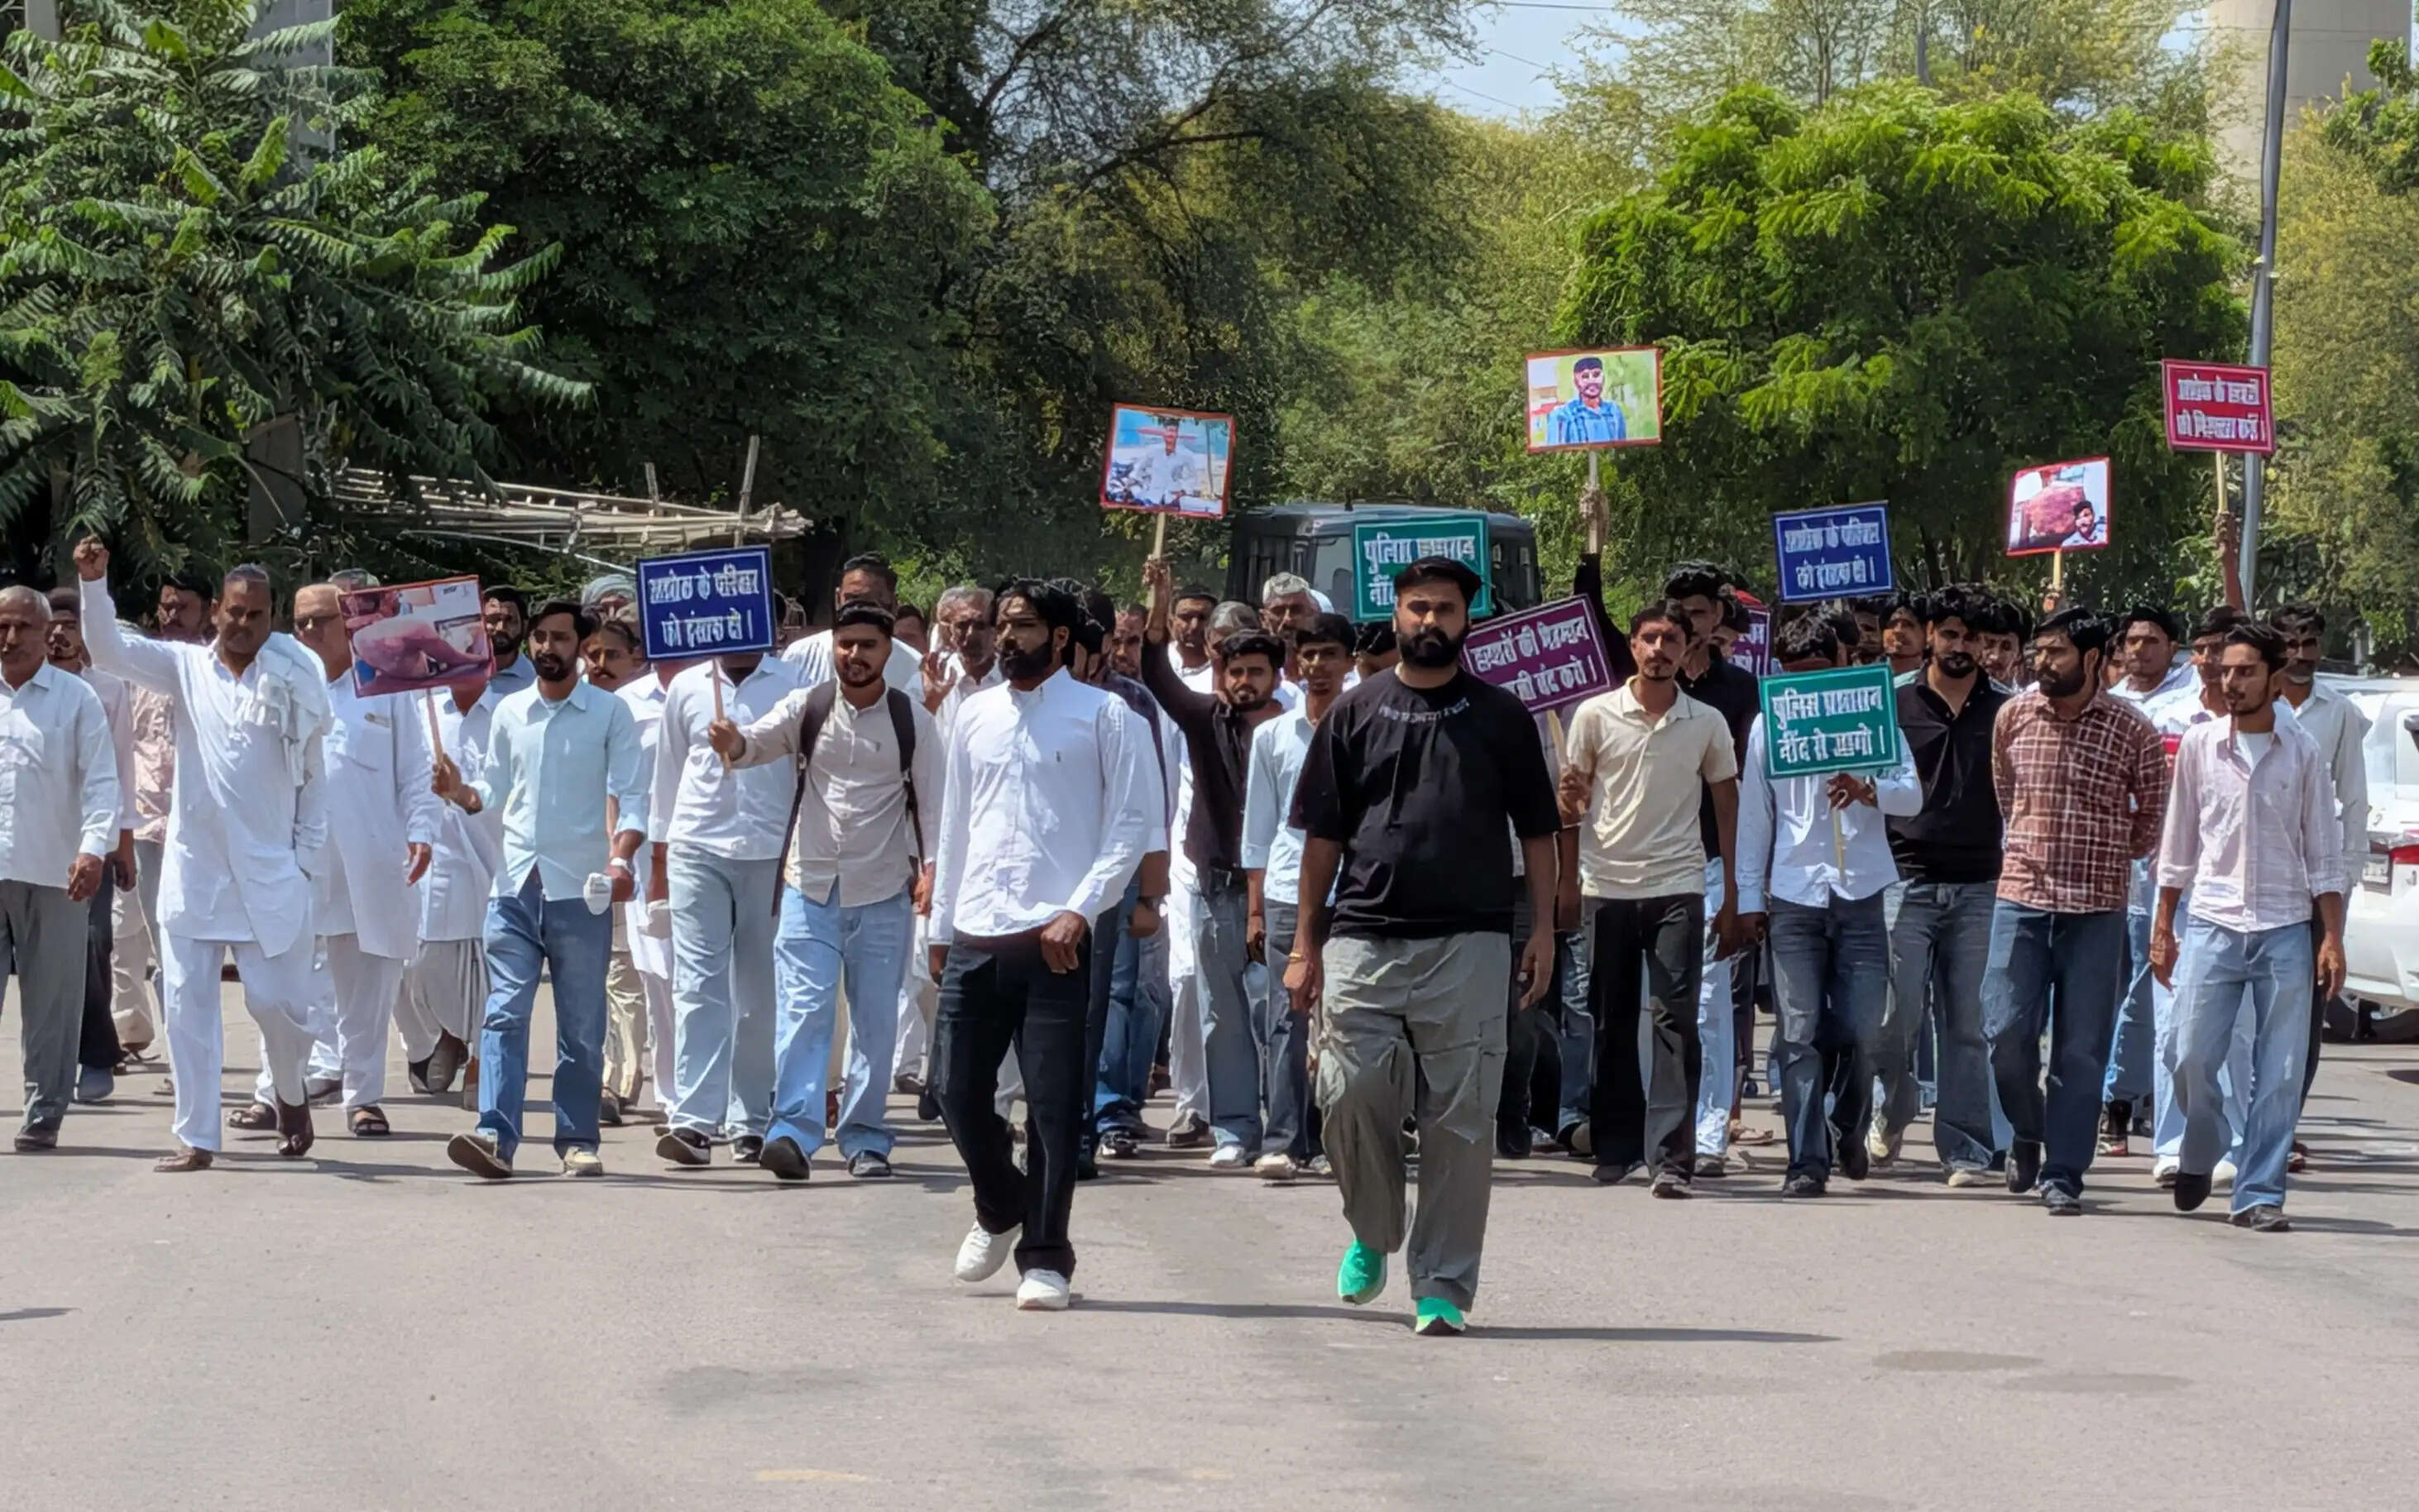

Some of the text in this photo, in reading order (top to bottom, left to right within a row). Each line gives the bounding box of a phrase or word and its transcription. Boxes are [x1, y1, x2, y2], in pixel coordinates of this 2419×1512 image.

[1363, 532, 1412, 575] पुलिस
[694, 565, 711, 600] के
[713, 563, 759, 597] परिवार
[661, 612, 682, 648] को
[1516, 624, 1540, 658] की
[1559, 655, 1588, 689] करो
[1771, 686, 1883, 730] पुलिस प्रशासन
[1777, 729, 1810, 764] नींद
[1813, 728, 1828, 761] से
[1832, 723, 1872, 757] जागो
